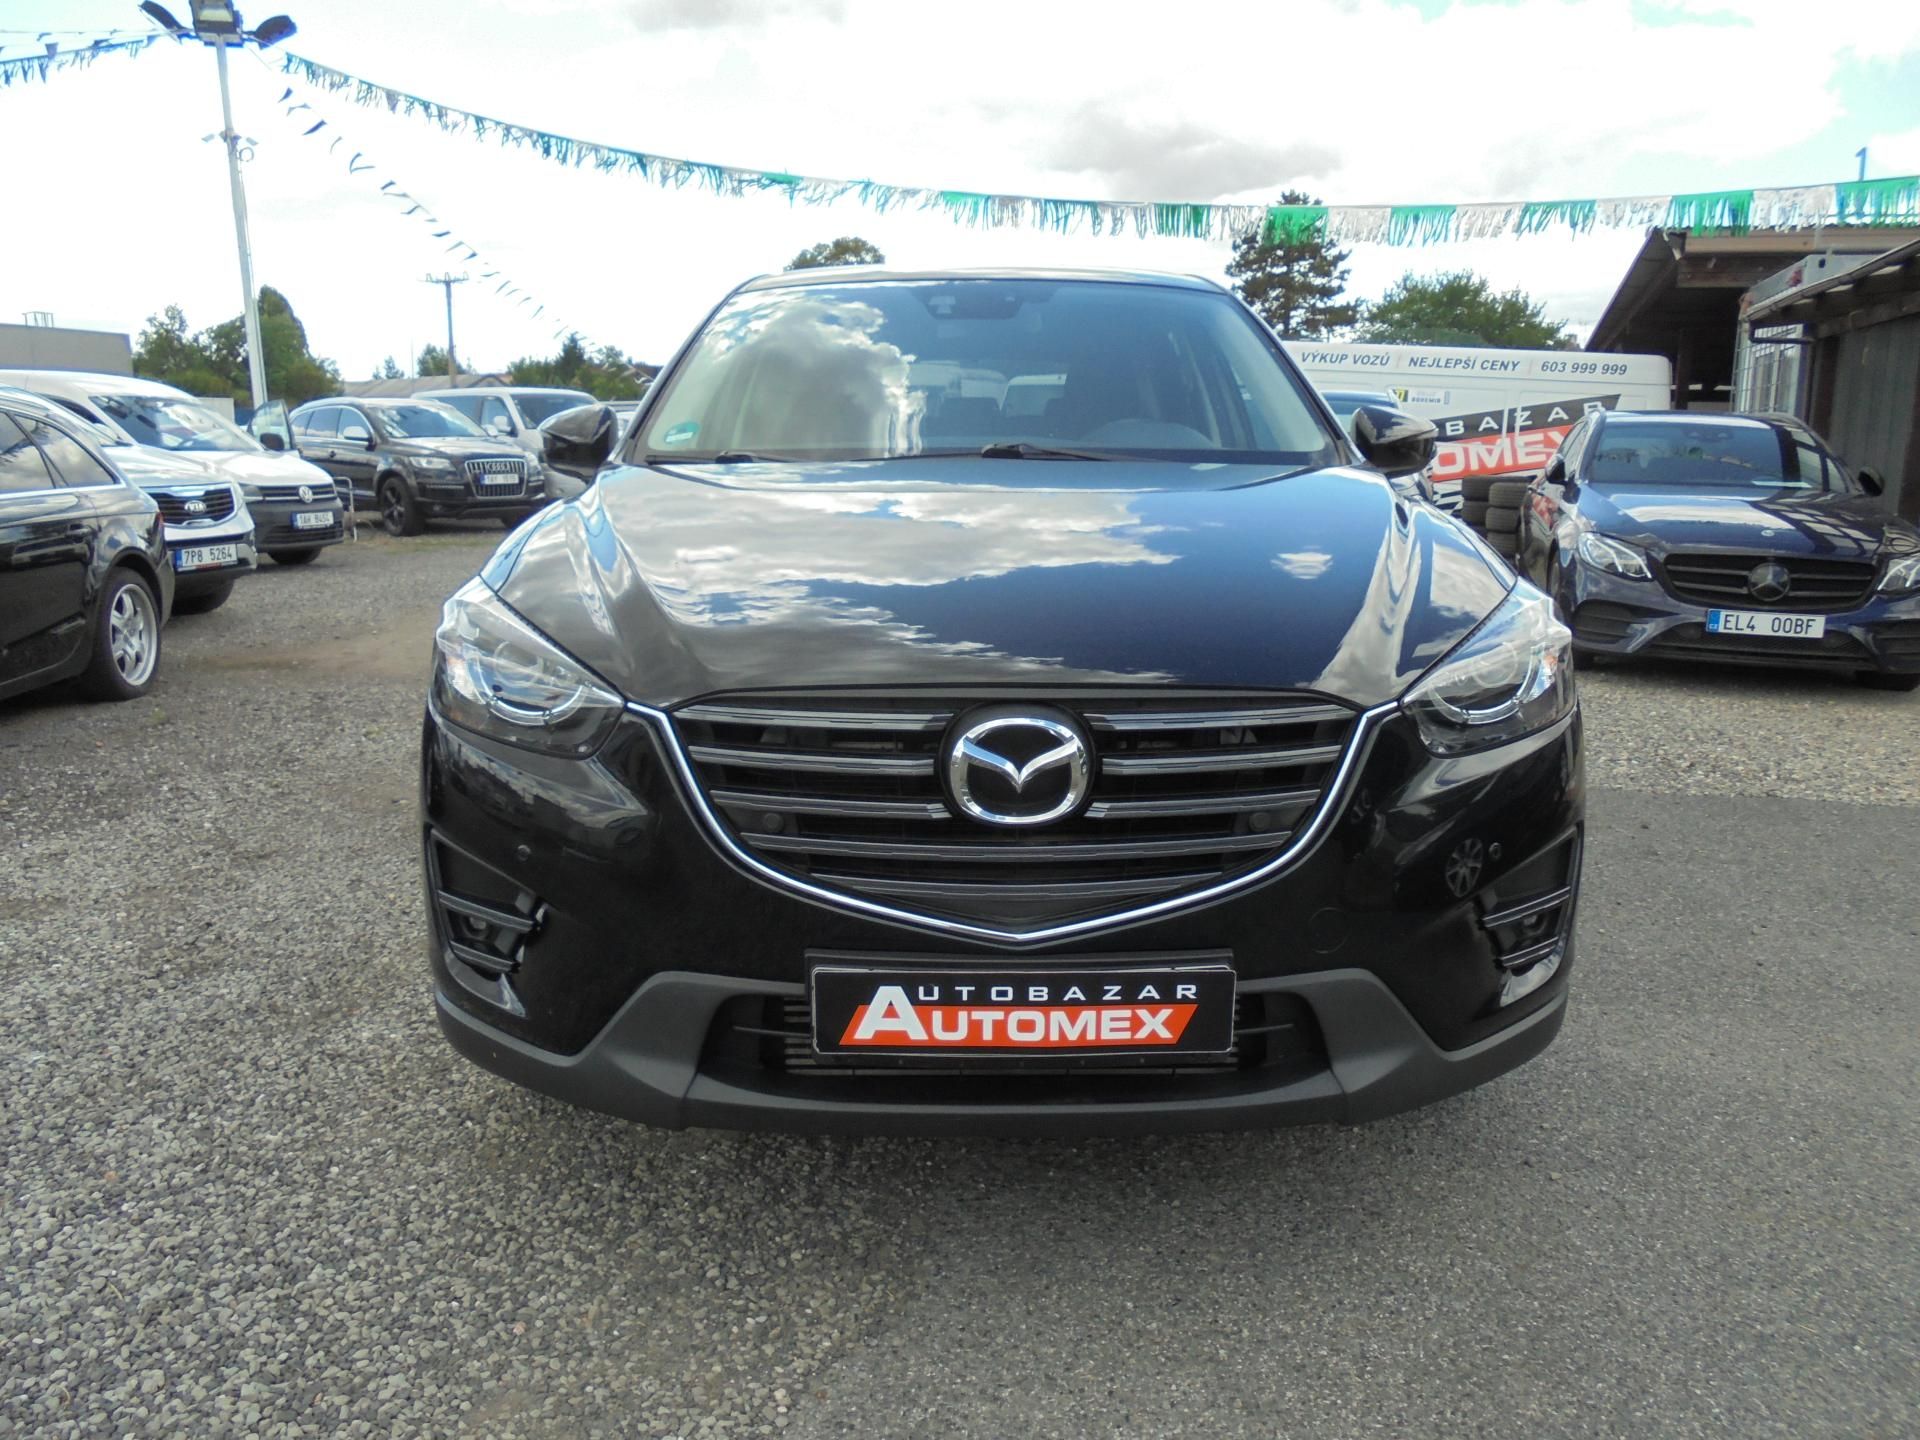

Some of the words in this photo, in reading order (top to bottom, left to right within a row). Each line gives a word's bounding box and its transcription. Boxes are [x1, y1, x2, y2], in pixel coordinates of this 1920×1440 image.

[1302, 350, 1348, 364] VÝKUP
[1408, 356, 1477, 369] NEJLEPŠÍ
[1480, 359, 1520, 371] CENY
[1541, 361, 1567, 372] 603
[1571, 362, 1597, 374] 999
[1601, 363, 1627, 375] 999
[184, 550, 203, 564] 7P8
[209, 546, 232, 561] 5264
[1723, 614, 1756, 631] EL4
[854, 985, 1174, 1041] AUTOMEX
